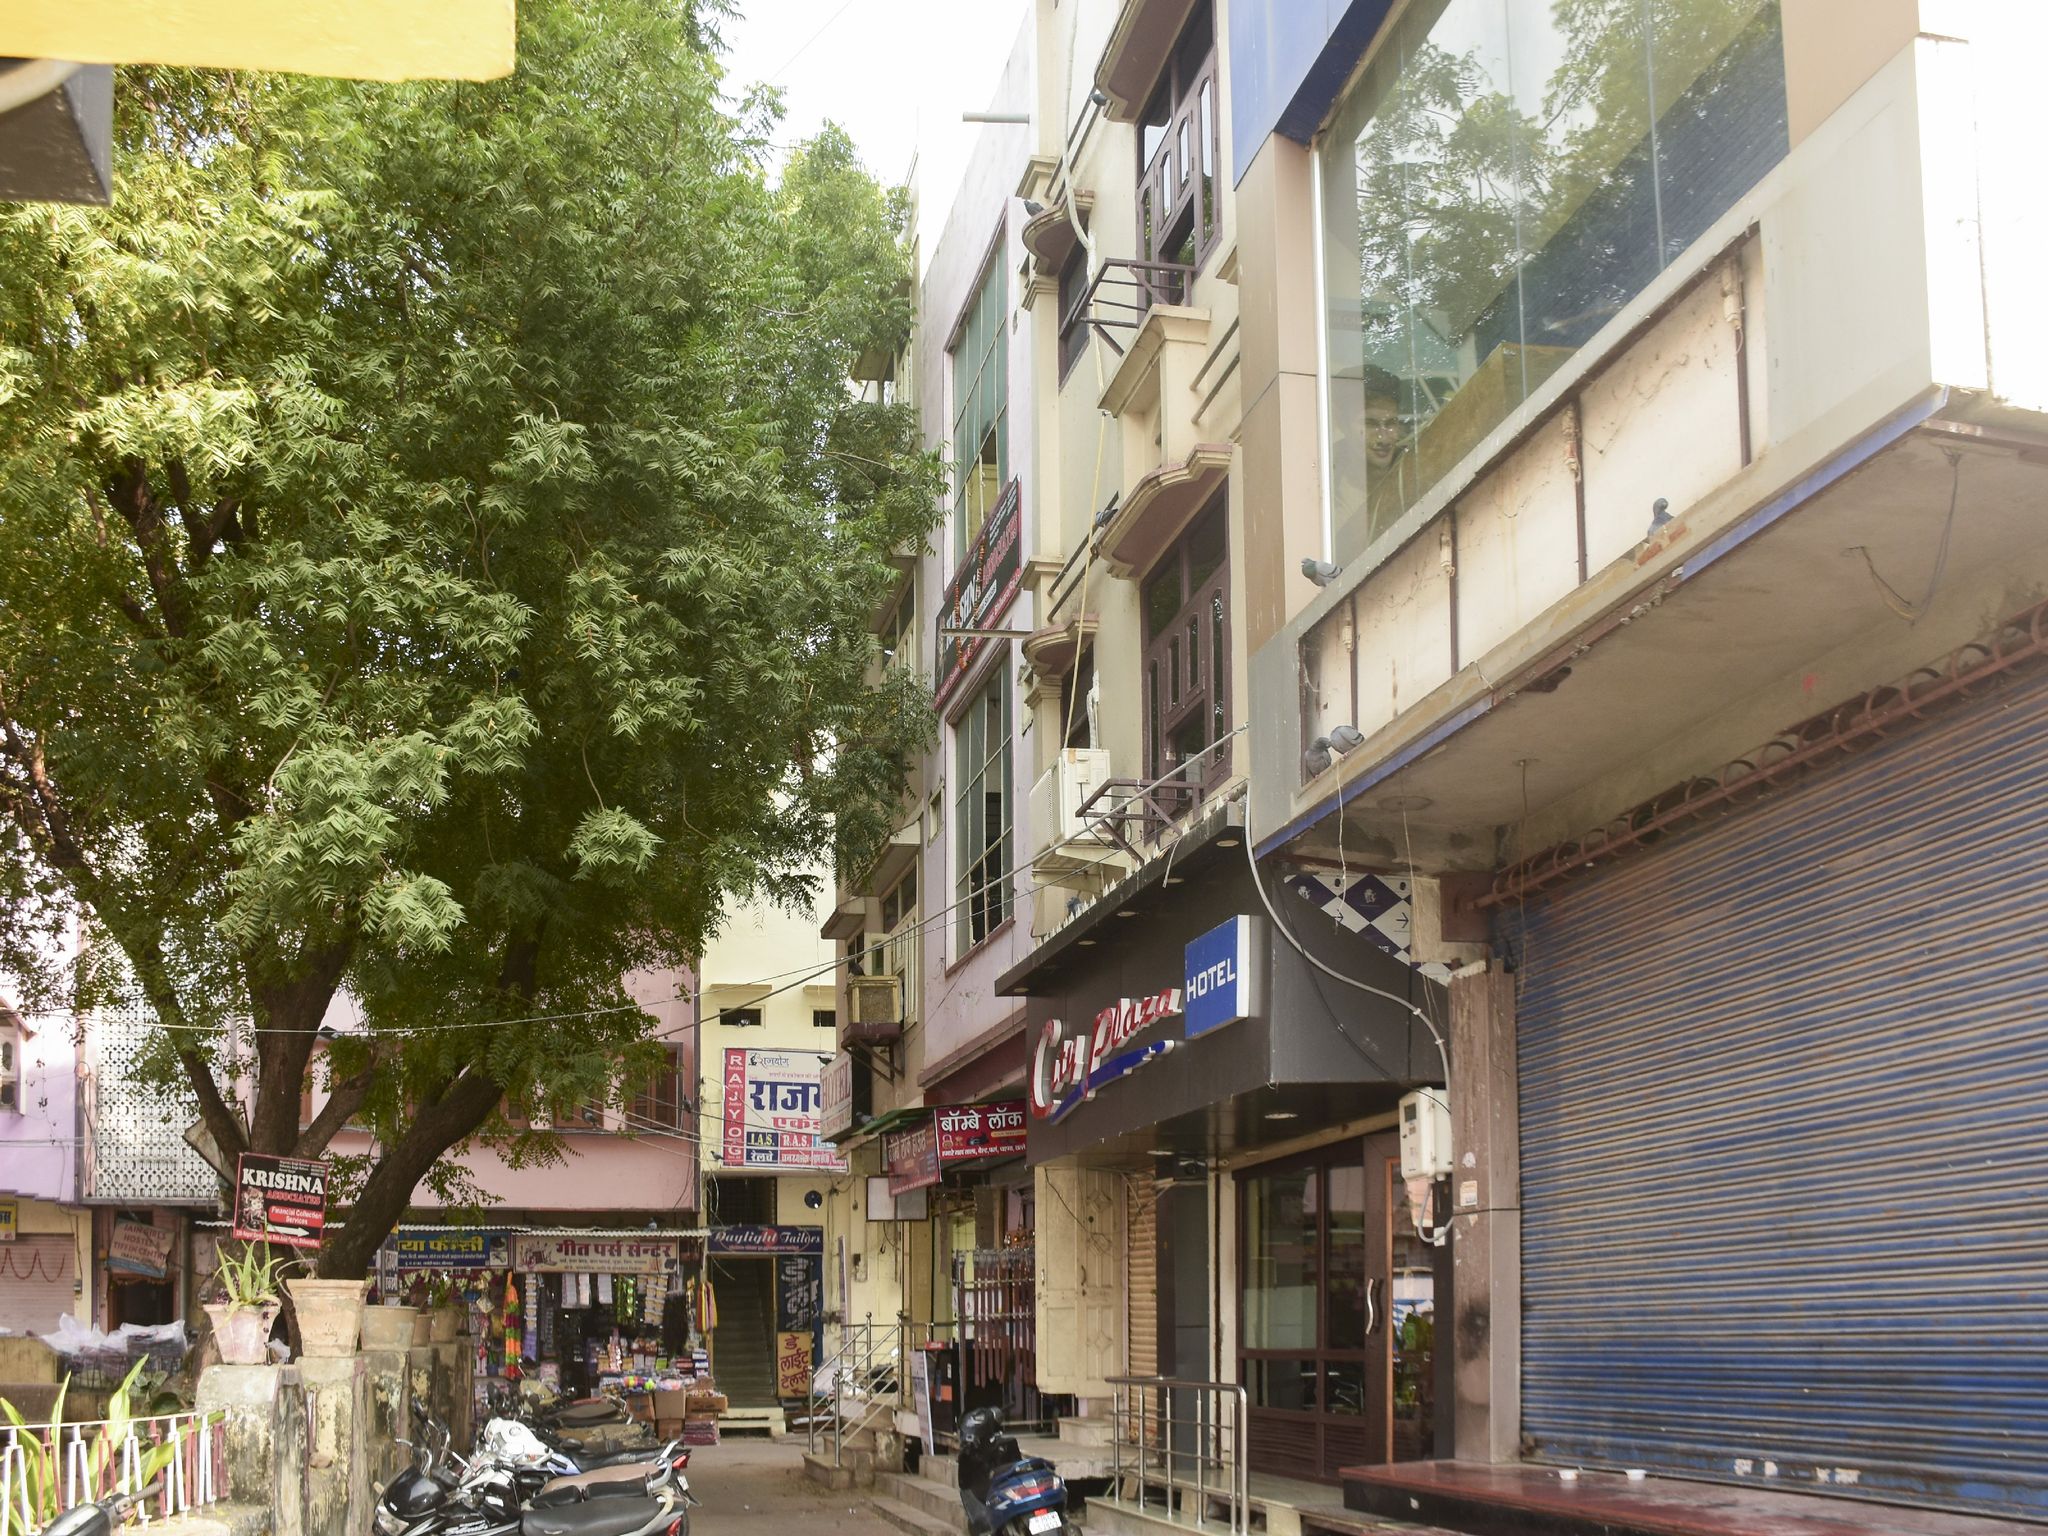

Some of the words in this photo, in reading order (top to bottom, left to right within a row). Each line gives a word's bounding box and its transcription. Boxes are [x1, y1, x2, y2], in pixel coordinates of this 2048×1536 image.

[1186, 957, 1236, 1003] HOTEL
[1085, 988, 1182, 1100] Plaza
[940, 1109, 981, 1132] बॉम्बे
[987, 1106, 1023, 1130] लॉक
[782, 1134, 810, 1147] R.A.S.
[241, 1168, 324, 1195] KRISHNA
[265, 1189, 321, 1205] ASSOCIATES
[271, 1206, 296, 1216] Financial
[296, 1209, 322, 1220] Collection
[285, 1215, 308, 1225] Services
[715, 1231, 778, 1245] Daylight
[780, 1231, 820, 1244] Tailors
[556, 1239, 591, 1256] गीत
[594, 1239, 624, 1257] पर्स
